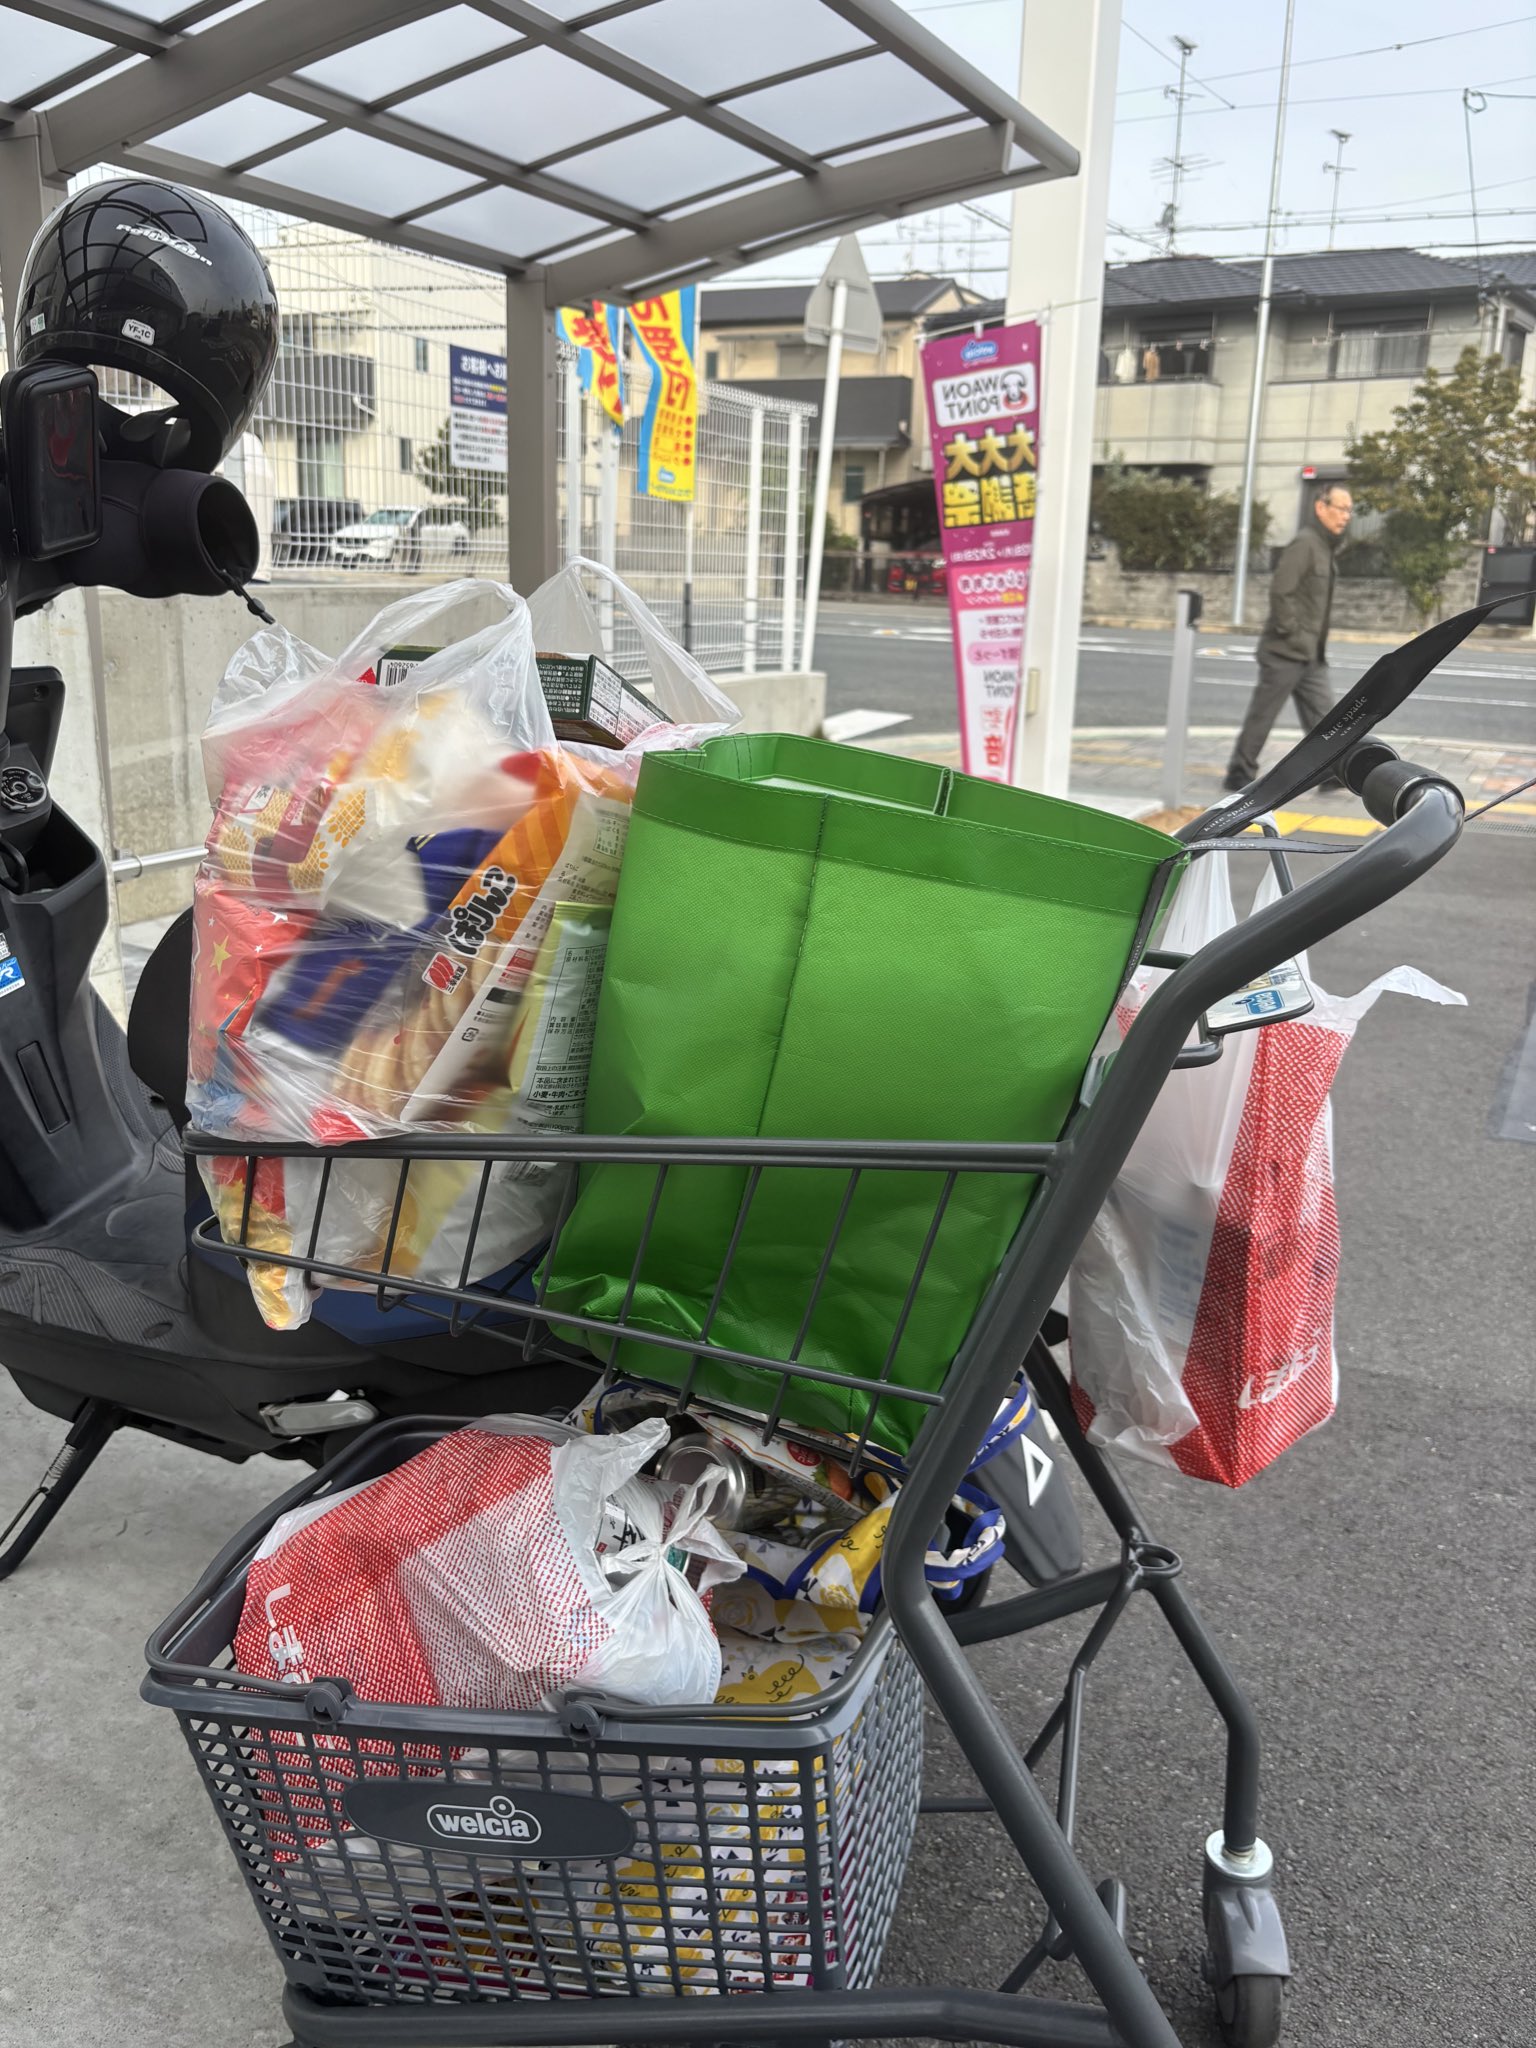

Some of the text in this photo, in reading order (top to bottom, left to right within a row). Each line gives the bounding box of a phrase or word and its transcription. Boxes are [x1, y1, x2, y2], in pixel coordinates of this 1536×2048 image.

[127, 324, 151, 339] YF-1C
[1320, 696, 1368, 741] kate spade
[1203, 816, 1225, 832] kate
[446, 866, 517, 957] ぱりんこ
[435, 1811, 531, 1838] welcia
